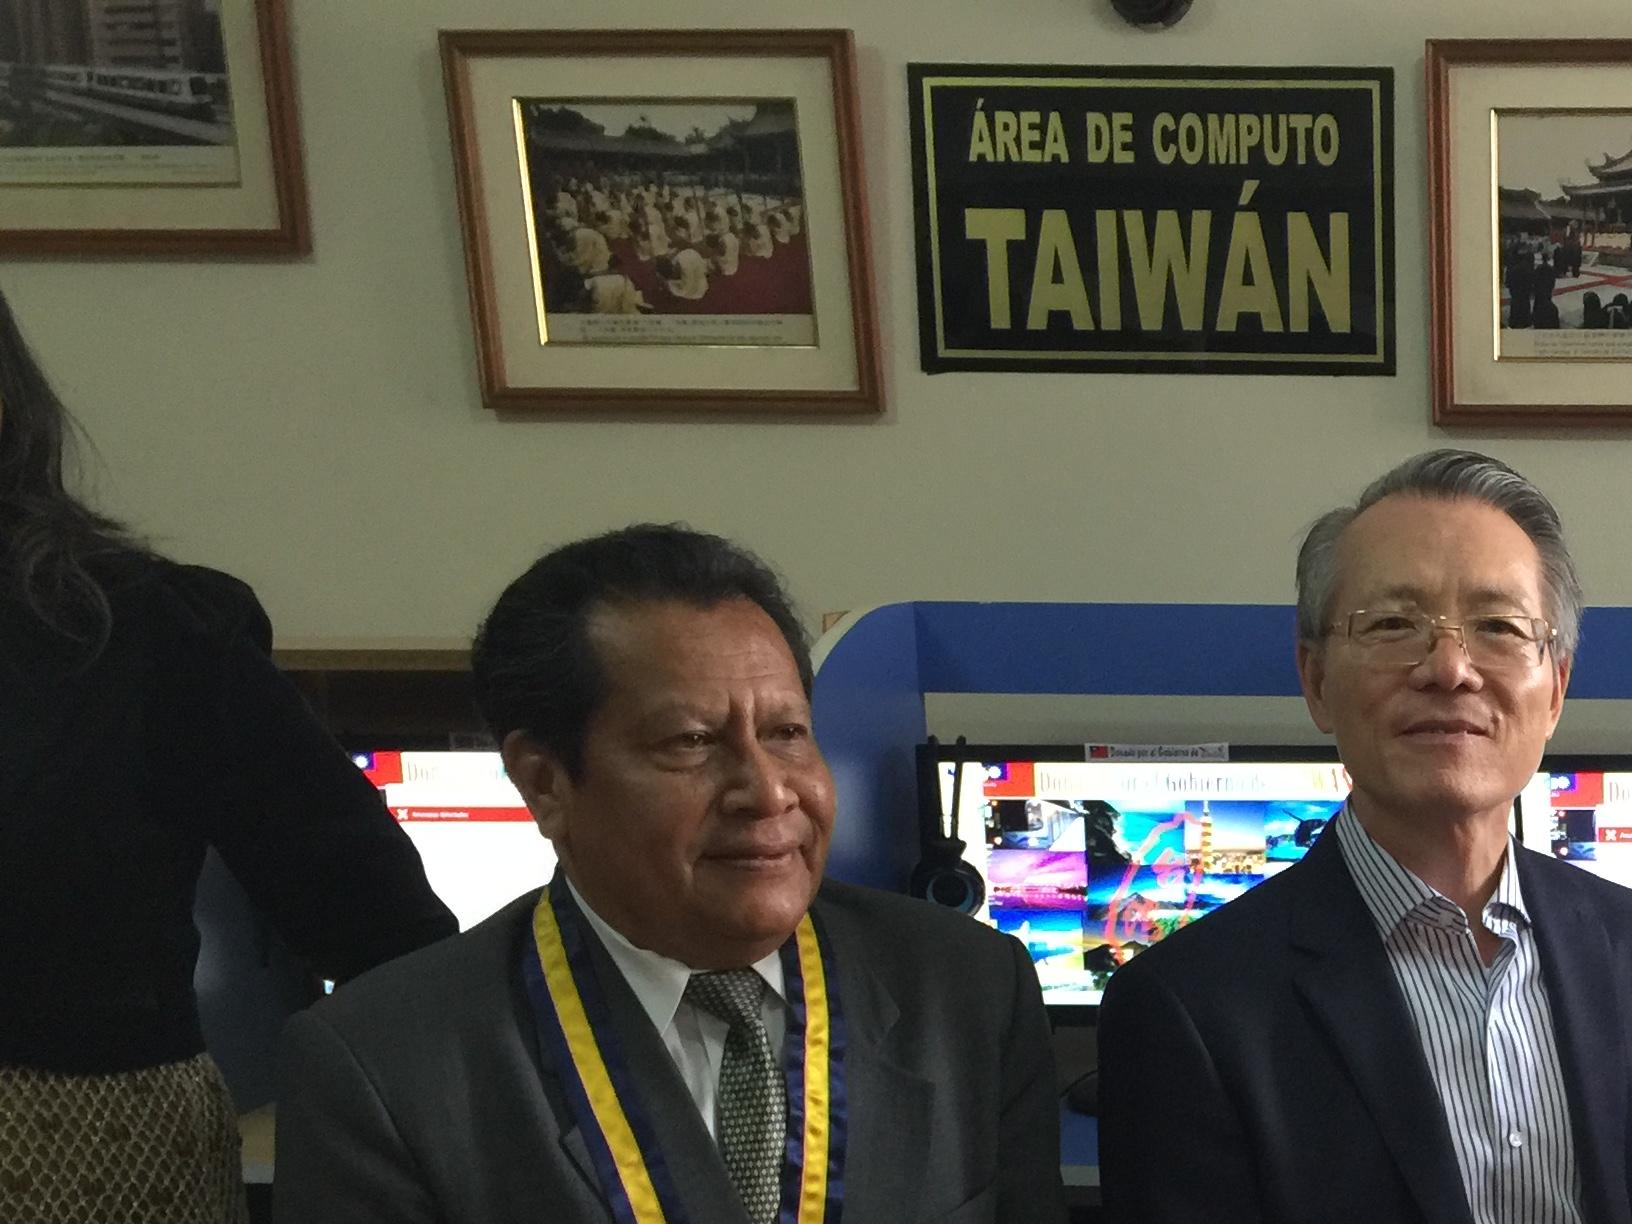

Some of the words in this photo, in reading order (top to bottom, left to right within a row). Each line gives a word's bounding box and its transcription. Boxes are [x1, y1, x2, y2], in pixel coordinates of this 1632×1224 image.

[968, 98, 1069, 163] ÁREA
[1086, 112, 1134, 163] DE
[1152, 112, 1340, 165] COMPUTO
[964, 179, 1352, 334] TAIWÁN
